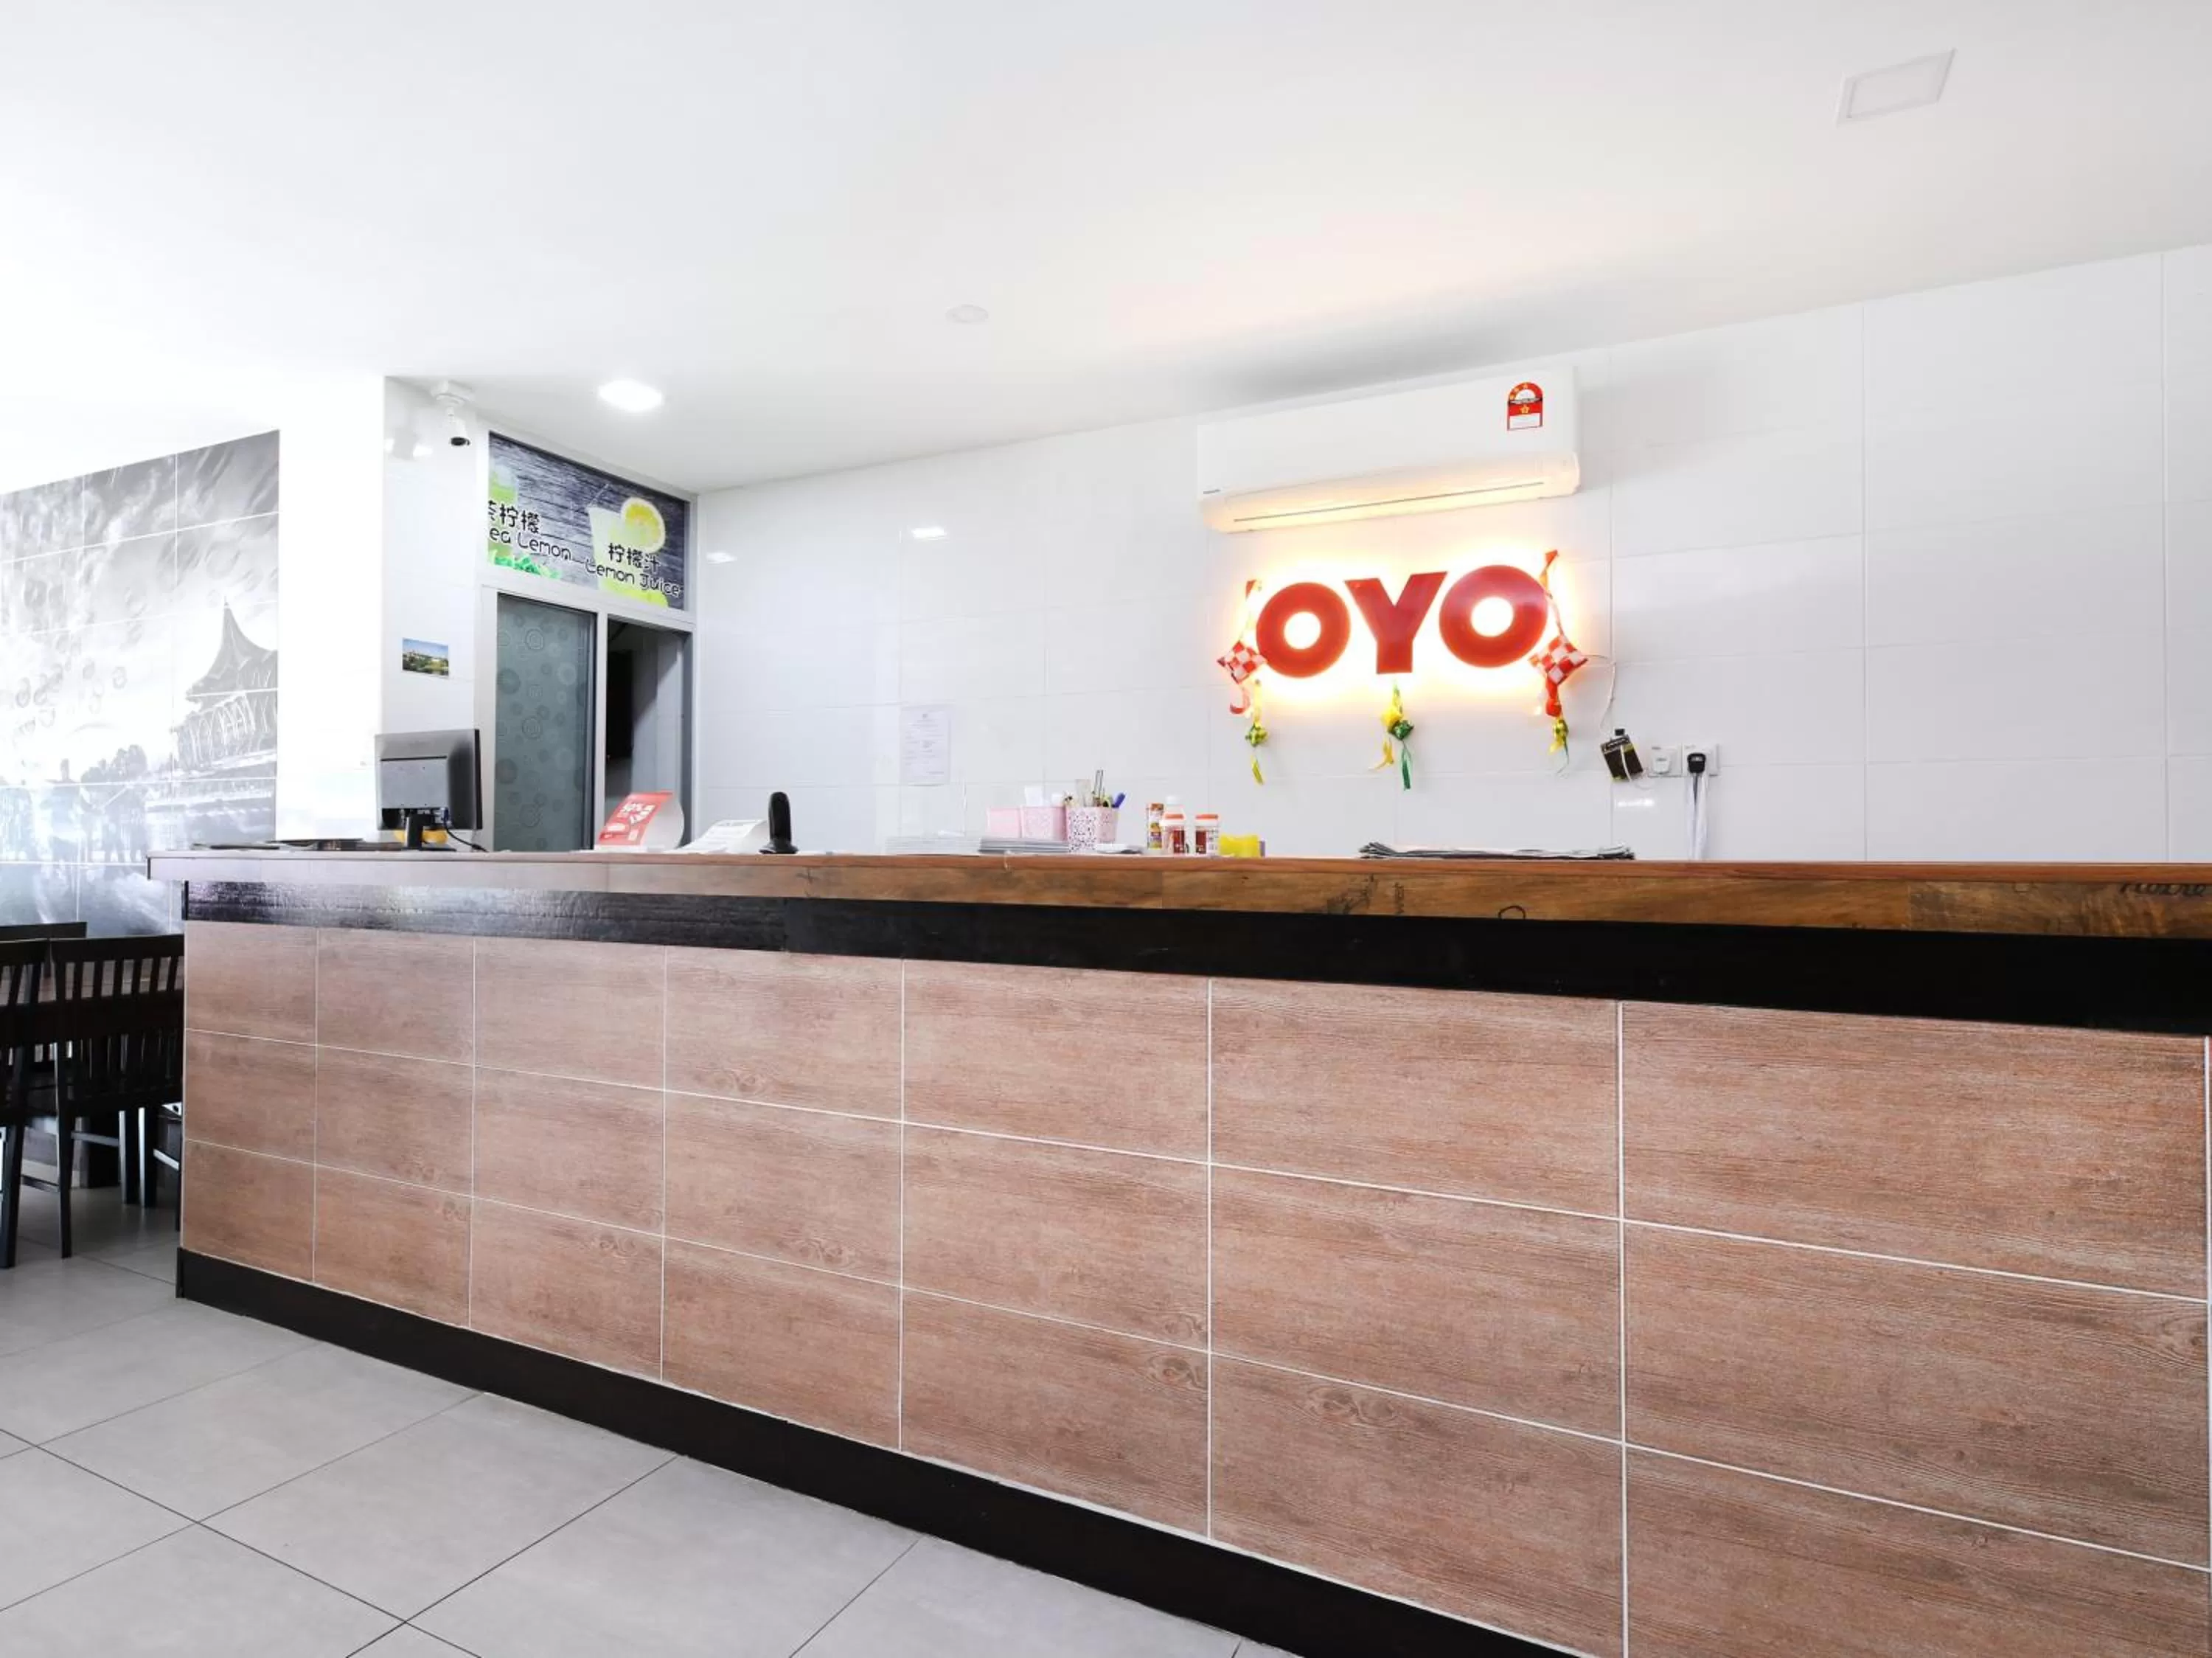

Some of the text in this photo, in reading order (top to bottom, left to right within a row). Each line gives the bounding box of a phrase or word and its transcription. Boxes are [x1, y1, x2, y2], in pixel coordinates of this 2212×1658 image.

[517, 532, 571, 561] Lemon
[608, 542, 659, 575] 柠檬汁
[585, 558, 680, 598] Lemon Juice
[1256, 565, 1548, 679] OYO
